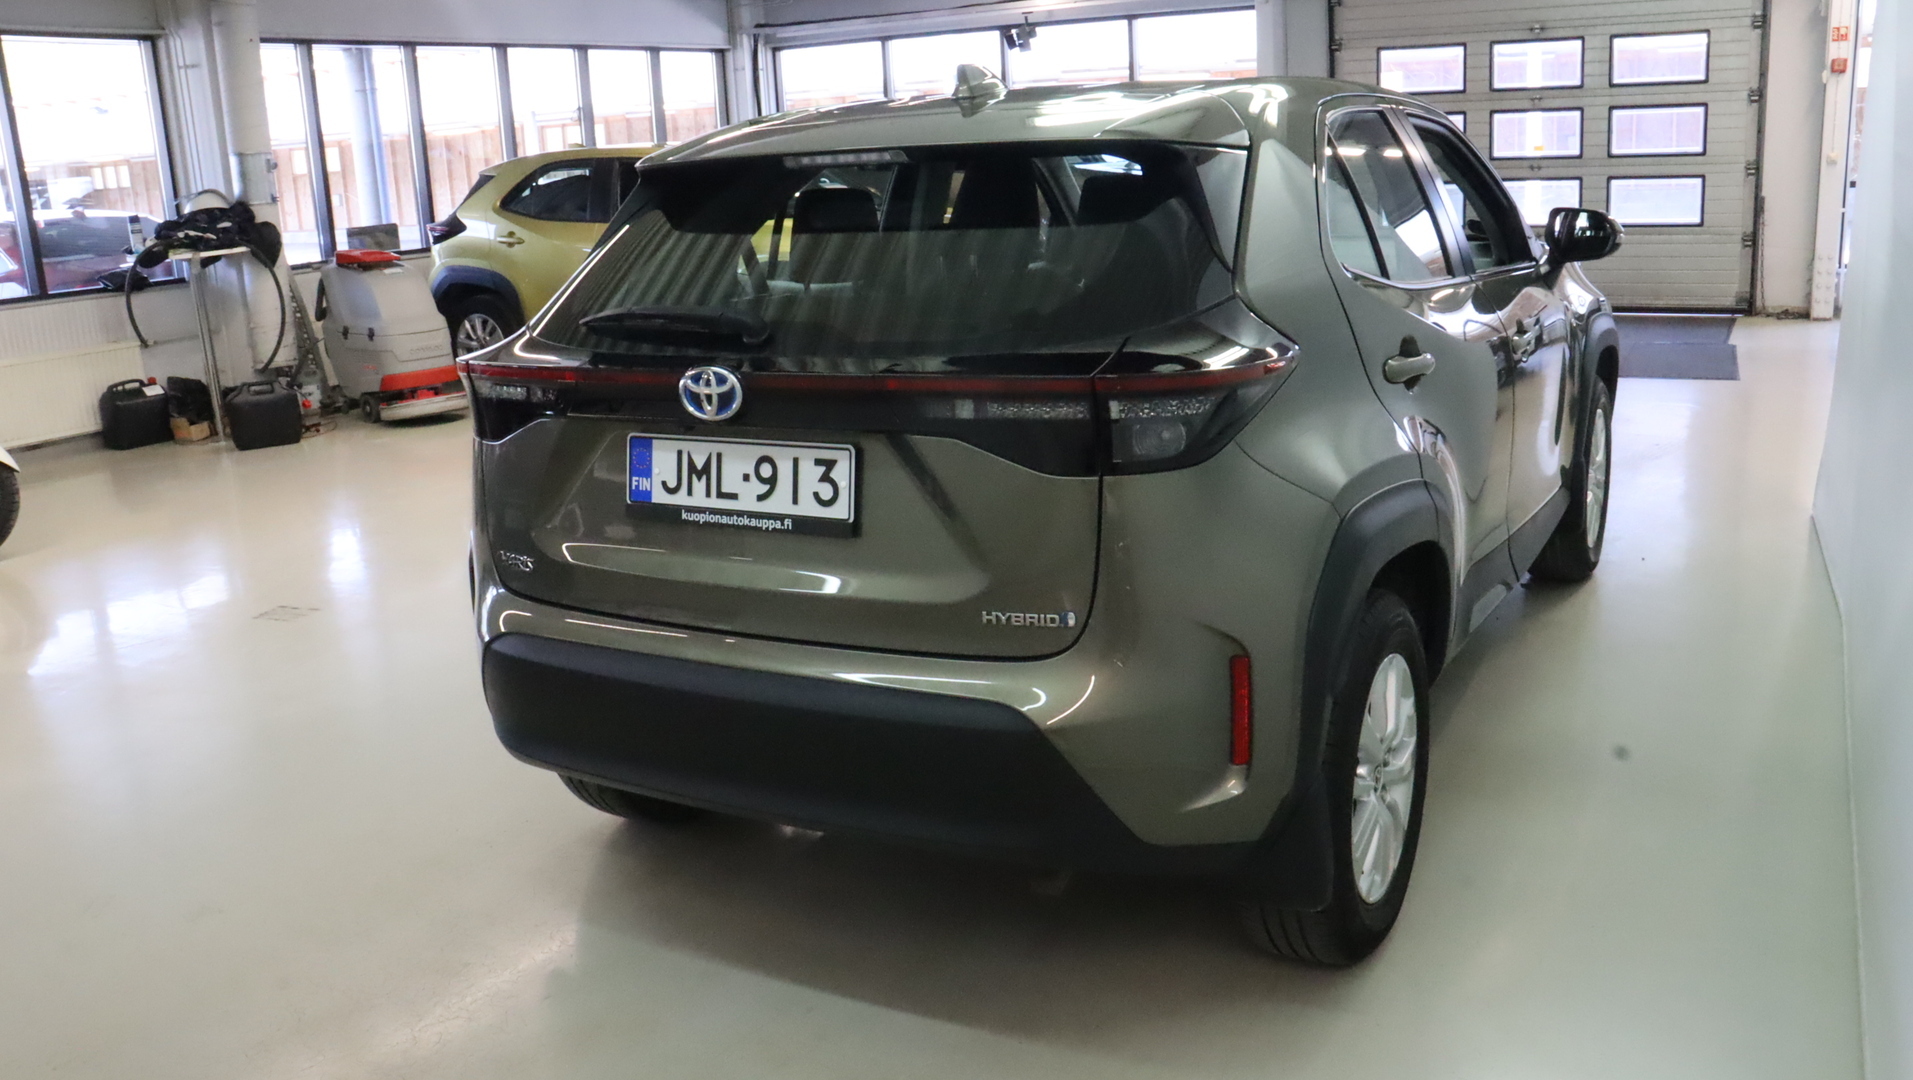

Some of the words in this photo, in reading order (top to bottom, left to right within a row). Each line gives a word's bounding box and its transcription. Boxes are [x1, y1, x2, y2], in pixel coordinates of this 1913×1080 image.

[631, 476, 651, 491] FIN
[681, 509, 792, 531] kuopionautokauppa.fi
[982, 611, 1060, 627] HYBRID
